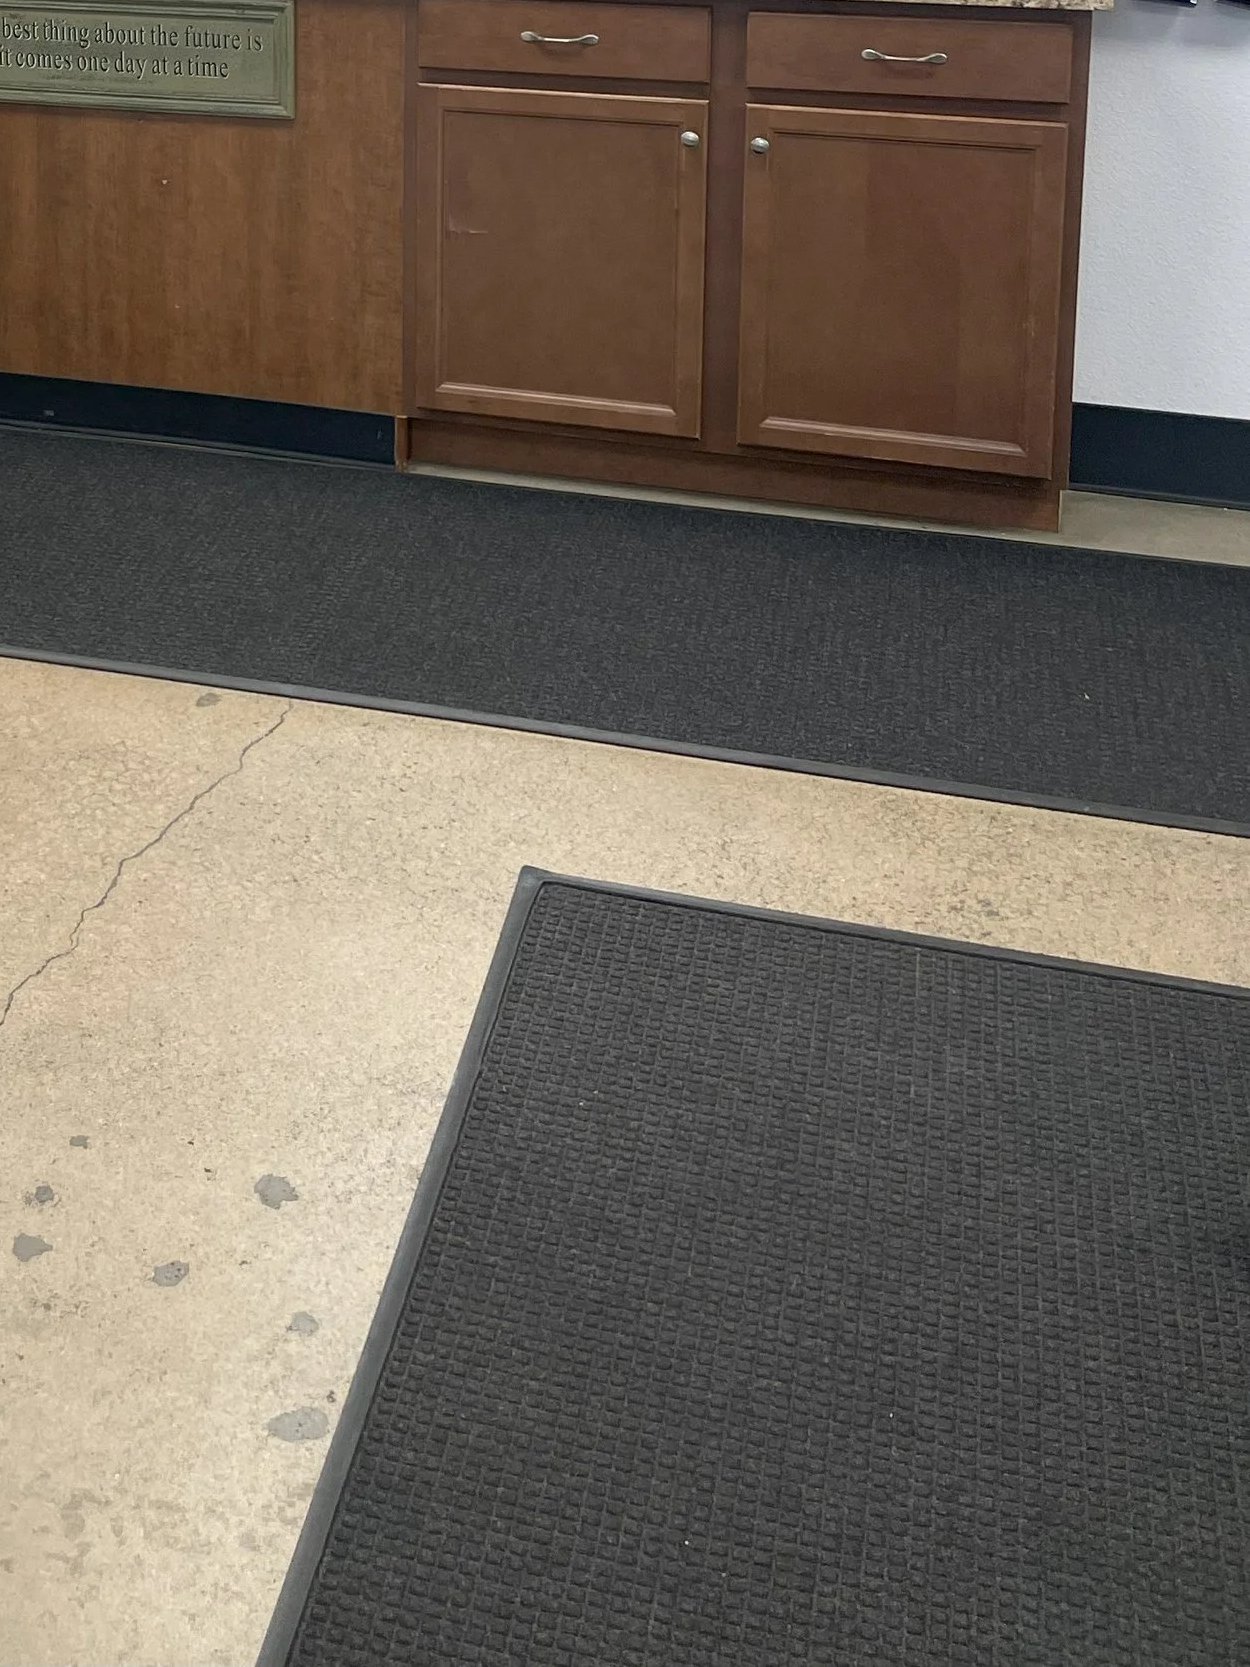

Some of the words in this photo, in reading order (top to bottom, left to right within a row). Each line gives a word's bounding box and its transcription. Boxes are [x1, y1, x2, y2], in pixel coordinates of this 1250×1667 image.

[2, 17, 39, 41] best
[43, 19, 91, 49] thing
[95, 21, 146, 46] about
[151, 24, 180, 47] the
[185, 25, 242, 51] future
[247, 29, 264, 51] is
[0, 44, 12, 68] it
[15, 51, 73, 70] comes
[77, 55, 110, 73] one
[115, 51, 148, 81] day
[152, 55, 169, 76] at
[173, 60, 183, 77] a
[188, 55, 230, 79] time
